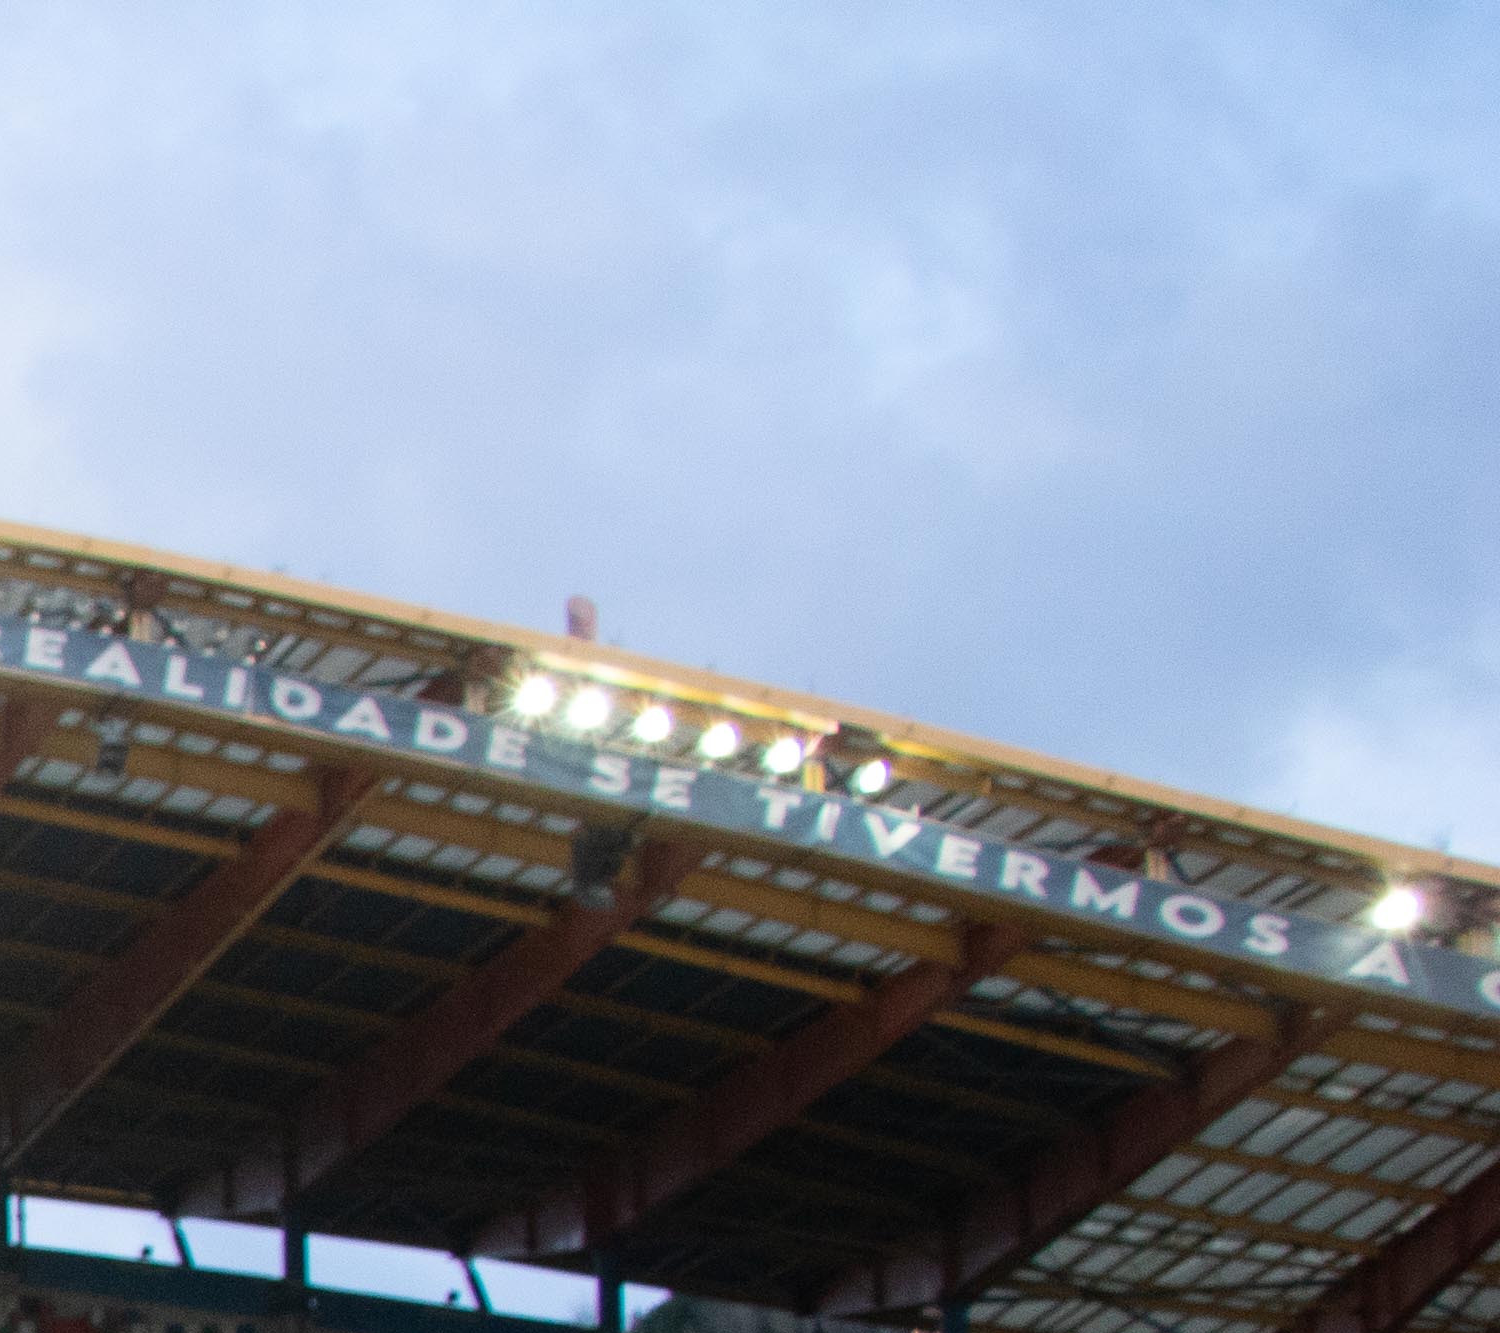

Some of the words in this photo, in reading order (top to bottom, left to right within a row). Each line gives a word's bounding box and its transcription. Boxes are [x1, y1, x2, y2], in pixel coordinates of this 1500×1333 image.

[588, 751, 699, 811] SE
[757, 786, 1291, 957] TIVERMOS
[1348, 942, 1412, 986] A
